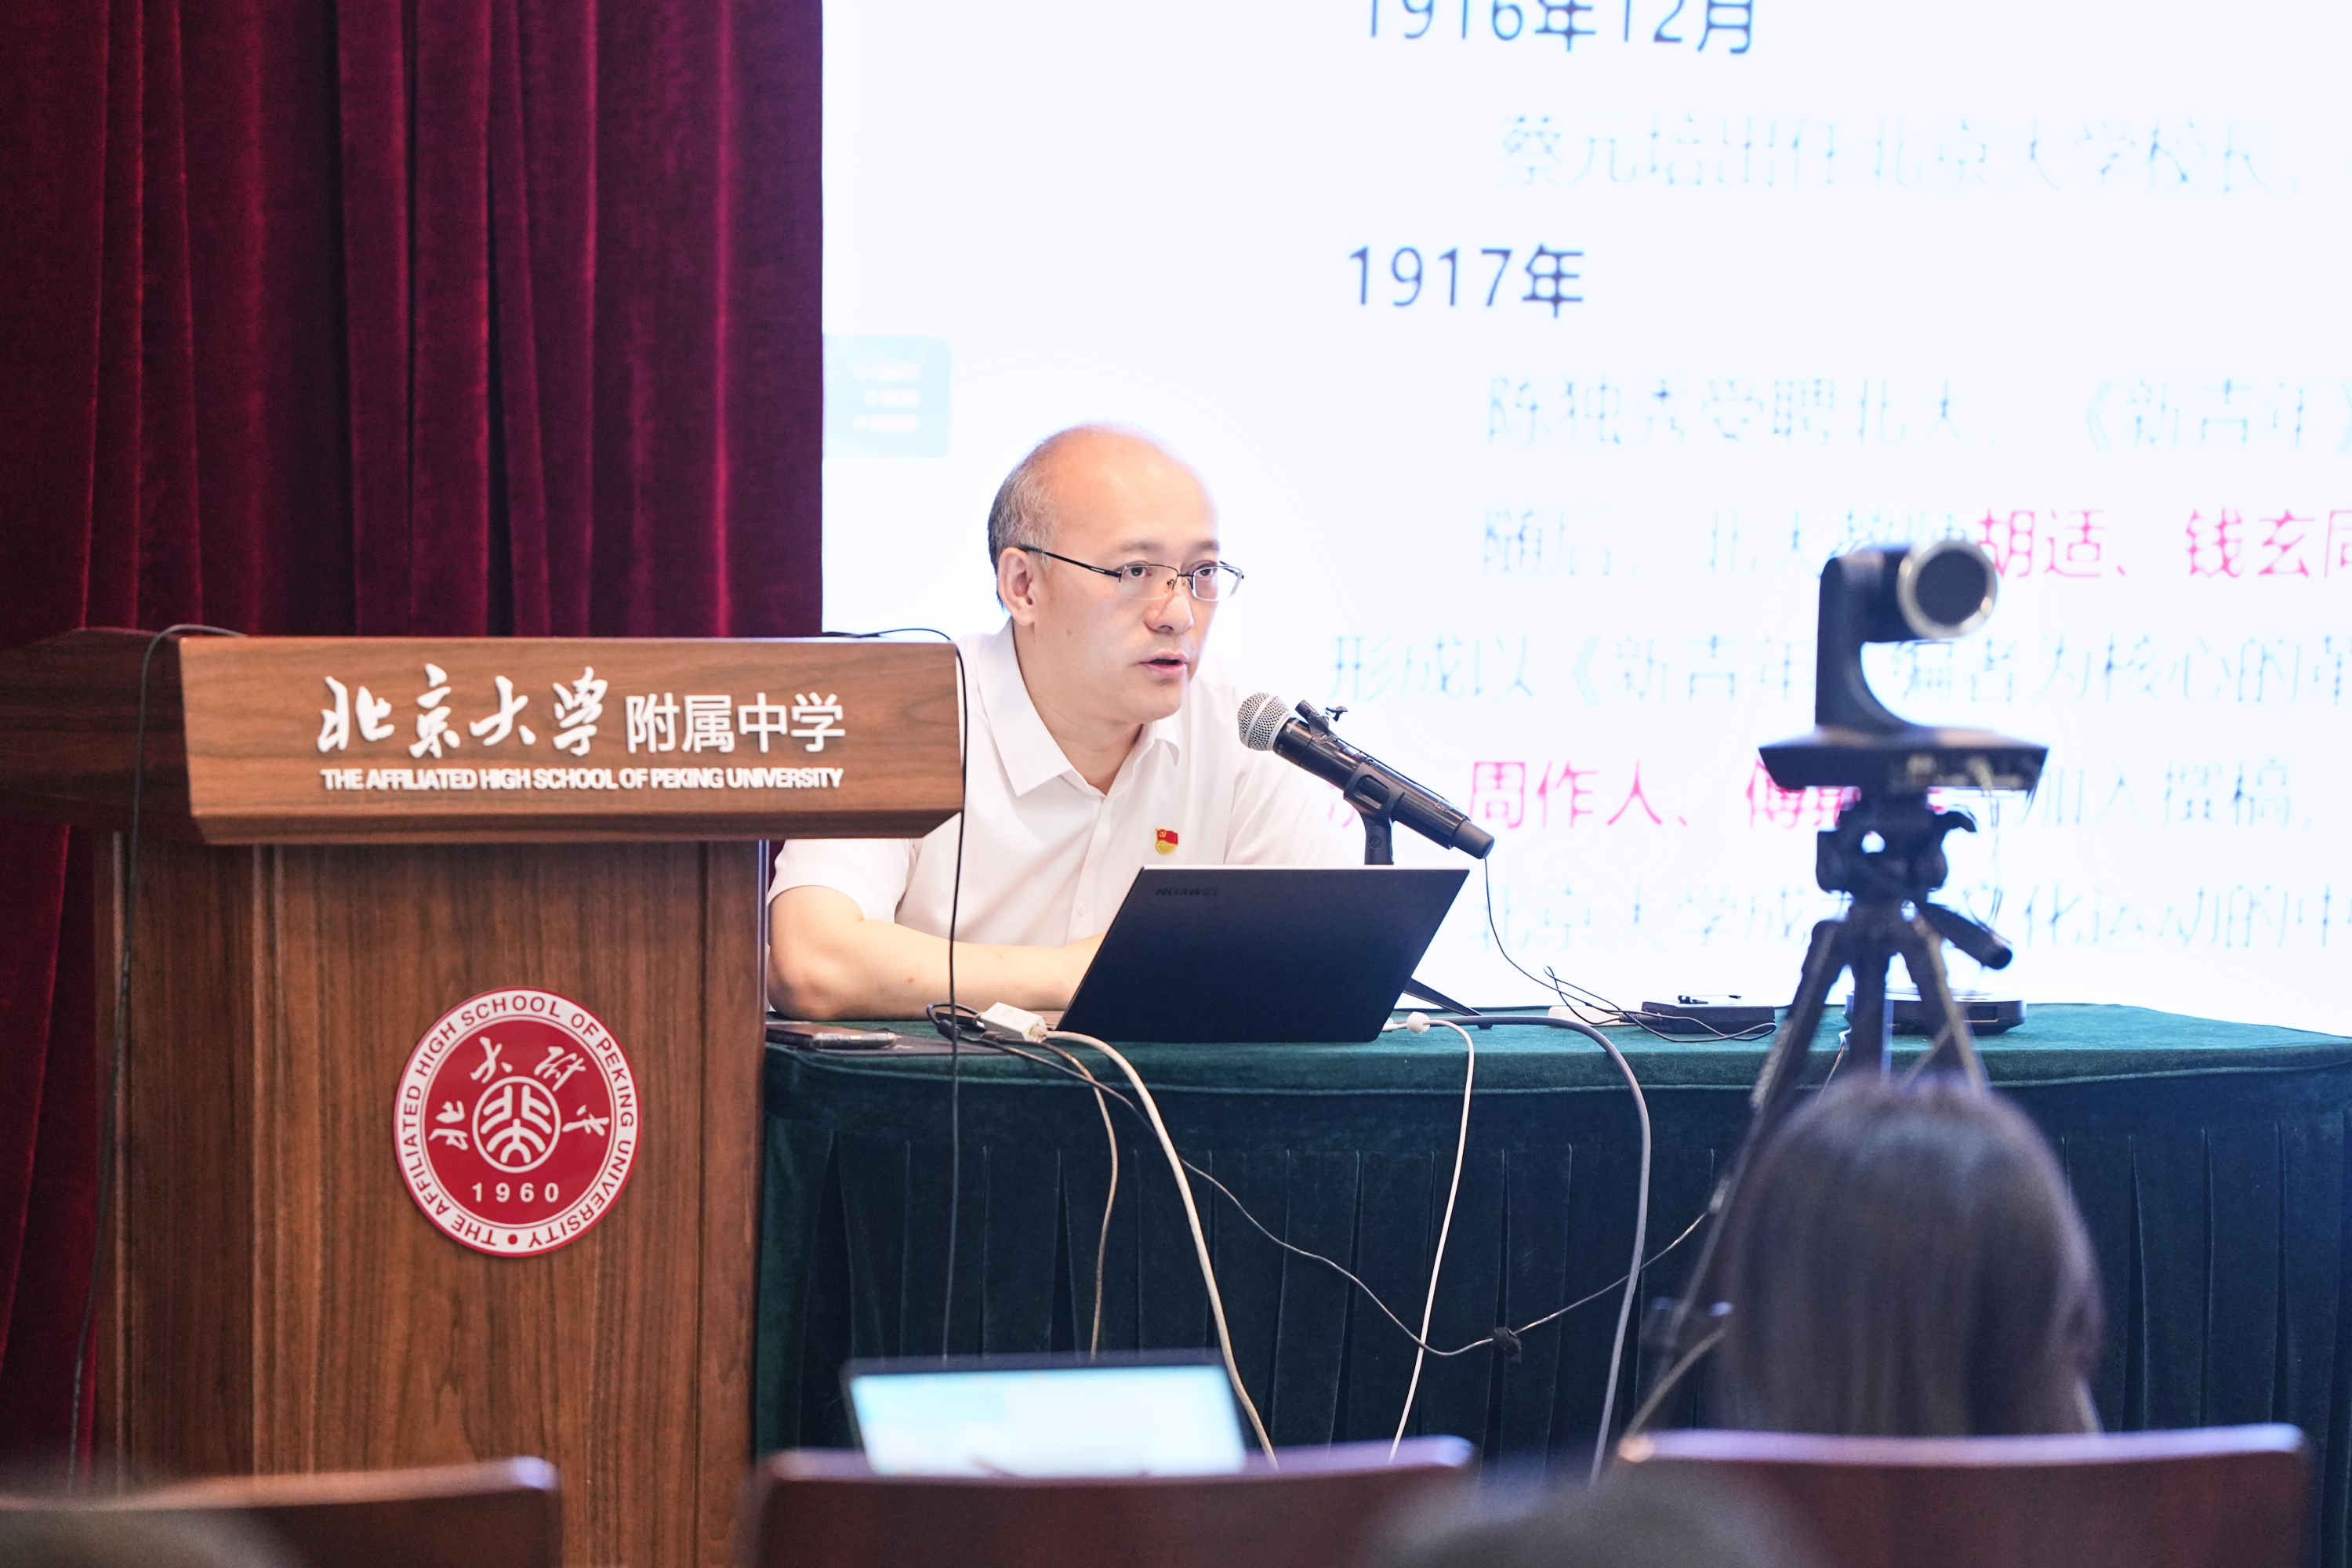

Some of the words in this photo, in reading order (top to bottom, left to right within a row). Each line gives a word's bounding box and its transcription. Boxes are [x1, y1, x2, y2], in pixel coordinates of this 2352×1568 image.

[1370, 0, 1754, 53] 1916年12月
[1348, 244, 1584, 318] 1917年
[625, 691, 846, 753] 附属中学
[320, 768, 363, 790] THE
[366, 768, 477, 790] AFFILIATED
[480, 768, 532, 790] HIGH
[533, 768, 619, 790] SCHOOL
[619, 768, 648, 789] OF
[650, 768, 724, 789] PEKING
[726, 768, 844, 789] UNIVERSITY
[1156, 886, 1218, 897] HUAWEI
[461, 995, 561, 1027] SCHOOL
[570, 1013, 599, 1038] OF
[416, 1022, 457, 1078] HIGH
[596, 1036, 634, 1127] PEKING
[402, 1085, 451, 1216] AFFILIATED
[472, 1182, 559, 1203] 1960
[528, 1141, 632, 1248] UNIVERSITY
[451, 1214, 496, 1247] THE
